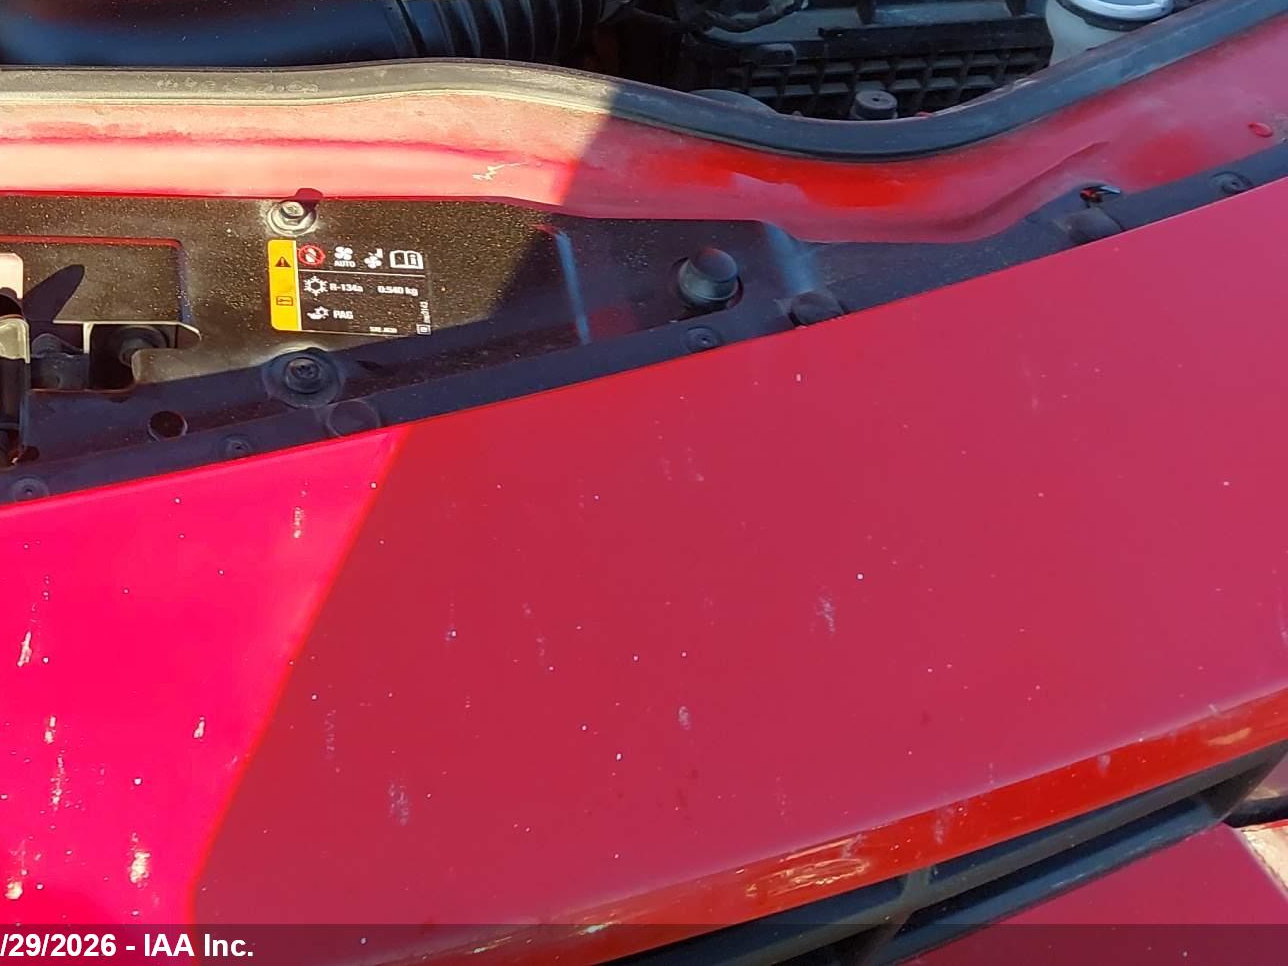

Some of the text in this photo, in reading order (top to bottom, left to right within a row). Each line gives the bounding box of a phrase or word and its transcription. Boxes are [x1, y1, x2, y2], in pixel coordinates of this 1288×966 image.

[334, 260, 356, 268] AUTO
[329, 283, 364, 292] R-134a
[405, 287, 418, 296] kg
[333, 309, 354, 320] PAG
